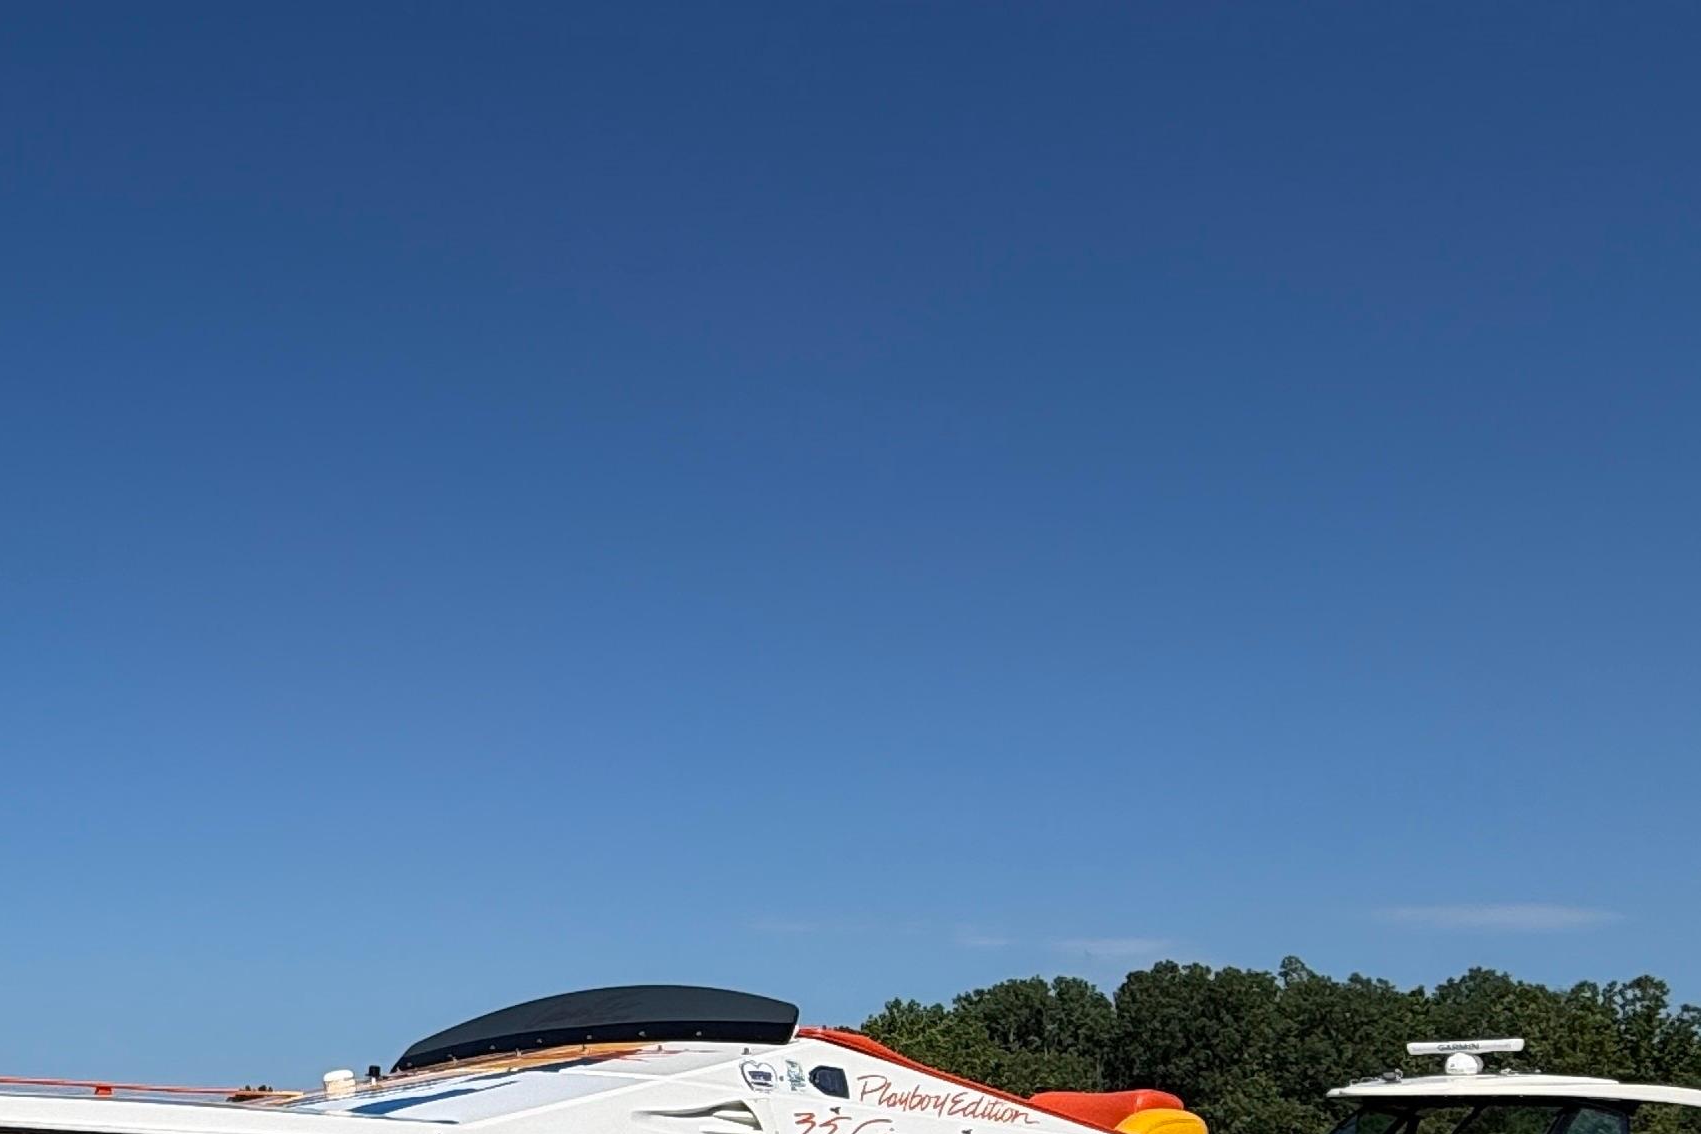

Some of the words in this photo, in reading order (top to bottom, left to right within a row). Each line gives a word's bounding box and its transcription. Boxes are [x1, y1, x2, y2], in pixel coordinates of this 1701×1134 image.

[1437, 1043, 1480, 1052] GARMIN
[857, 1074, 950, 1117] Playboy
[948, 1091, 1040, 1125] Edition
